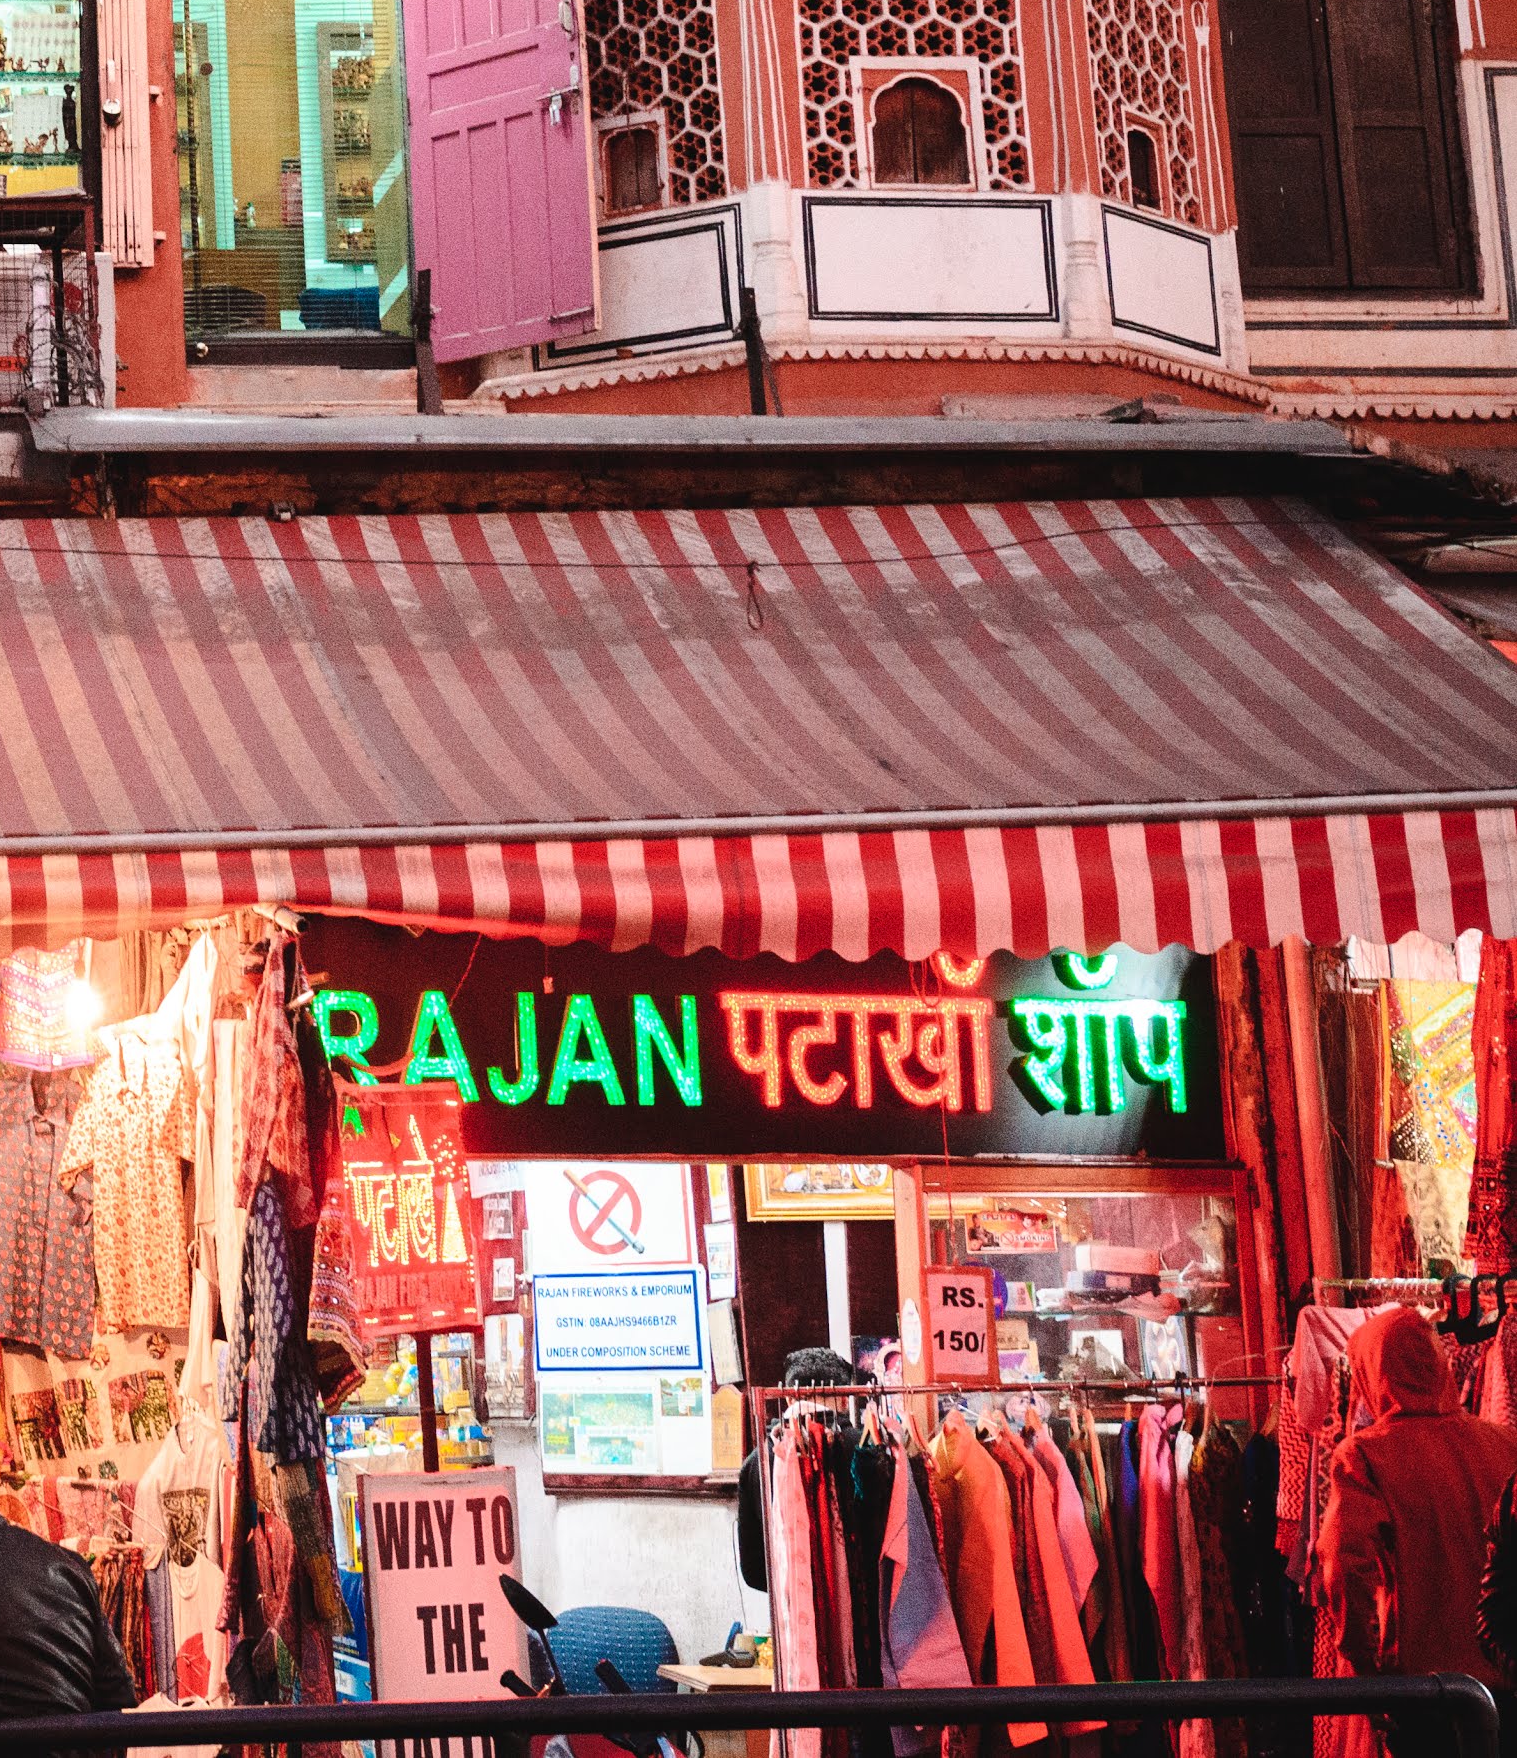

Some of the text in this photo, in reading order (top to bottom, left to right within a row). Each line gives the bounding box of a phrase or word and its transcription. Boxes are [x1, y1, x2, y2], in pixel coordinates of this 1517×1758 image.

[312, 989, 702, 1109] RAJAN
[538, 1285, 691, 1298] RAJAN FIREWORKS EMPORIUM
[941, 1286, 985, 1309] RS.
[556, 1318, 587, 1328] GSTIN:
[546, 1346, 691, 1358] UNDER COMPOSITION SCHEME
[373, 1495, 515, 1571] WAY TO
[416, 1603, 489, 1675] THE
